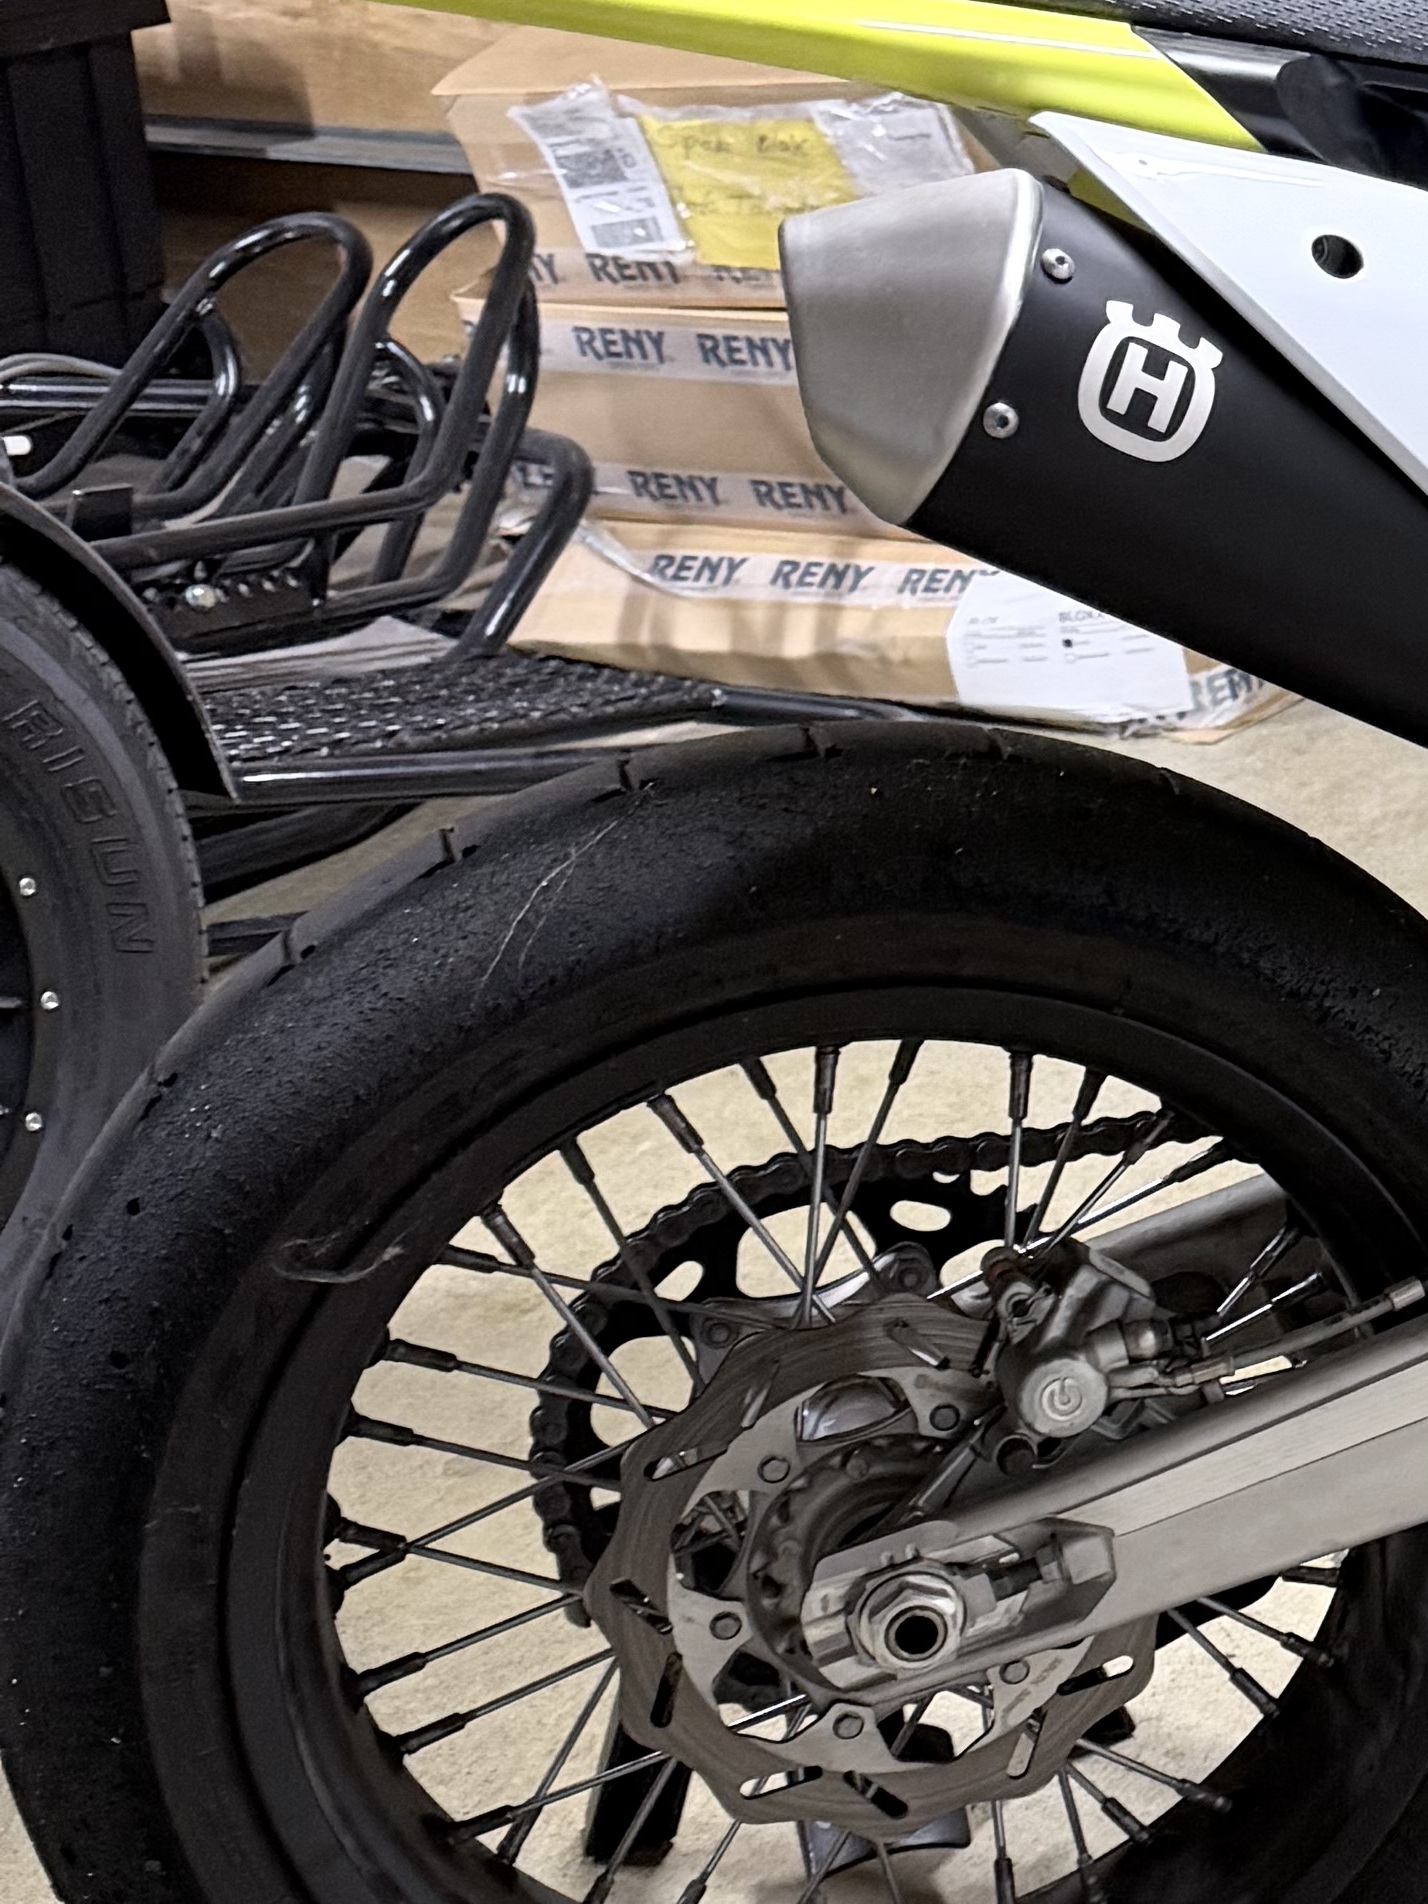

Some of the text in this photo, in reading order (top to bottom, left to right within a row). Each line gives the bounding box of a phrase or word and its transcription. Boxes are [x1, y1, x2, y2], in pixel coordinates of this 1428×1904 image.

[571, 326, 792, 373] RENY RENY
[627, 470, 849, 516] RENY RENY
[652, 554, 752, 587] RENY
[769, 559, 875, 594] RENY
